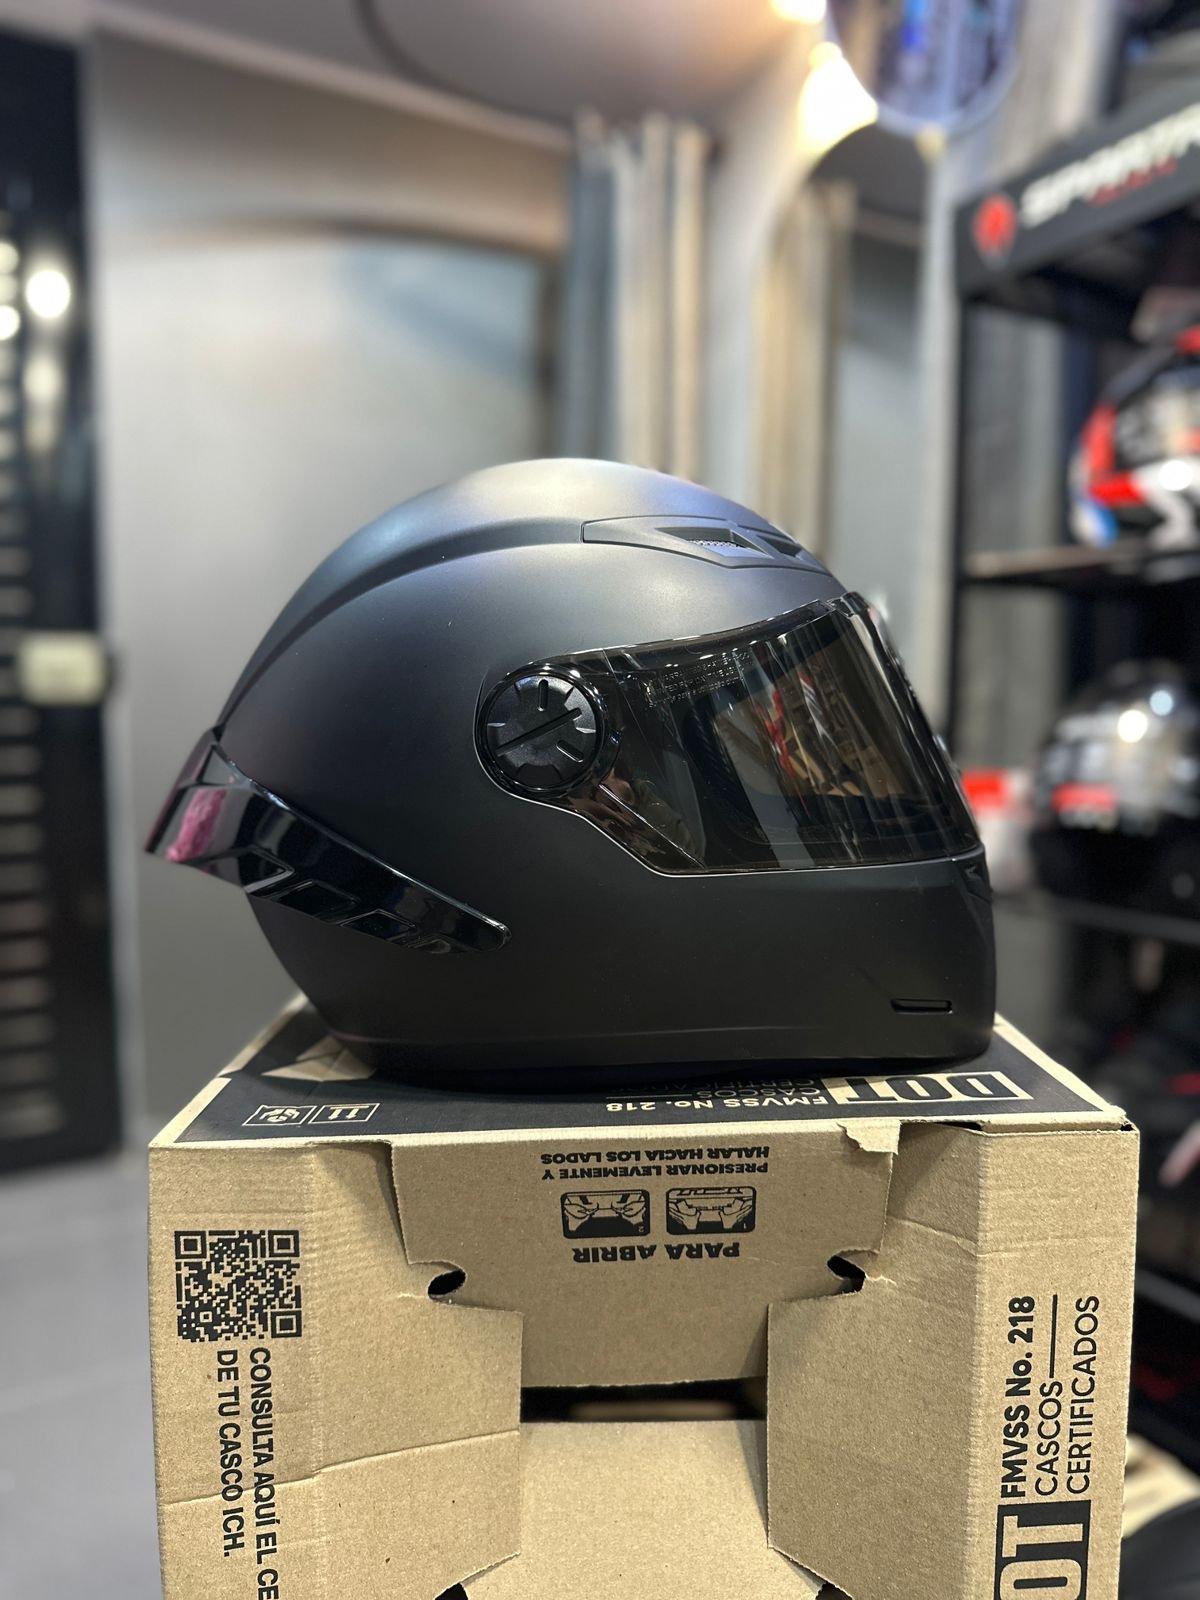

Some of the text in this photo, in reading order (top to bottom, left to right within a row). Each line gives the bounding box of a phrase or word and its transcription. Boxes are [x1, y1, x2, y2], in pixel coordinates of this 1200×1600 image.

[606, 1096, 829, 1112] FMVSS No. 218
[697, 1087, 821, 1098] CASCOS
[845, 1073, 1019, 1102] DOT
[541, 1146, 770, 1165] HALAR HACIA LOS LADOS
[542, 1163, 769, 1180] PRESIONAR LEVEMENTE Y
[572, 1242, 740, 1263] PARA ABRIR
[250, 1347, 274, 1468] CONSULTA
[1001, 1295, 1035, 1498] FMVSS No. 218
[1066, 1295, 1099, 1494] CERTIFICADOS
[217, 1349, 245, 1557] DE TU CASCO ICH.
[1035, 1381, 1063, 1496] CASCOS
[253, 1472, 280, 1527] AQUÍ
[256, 1532, 277, 1565] EL
